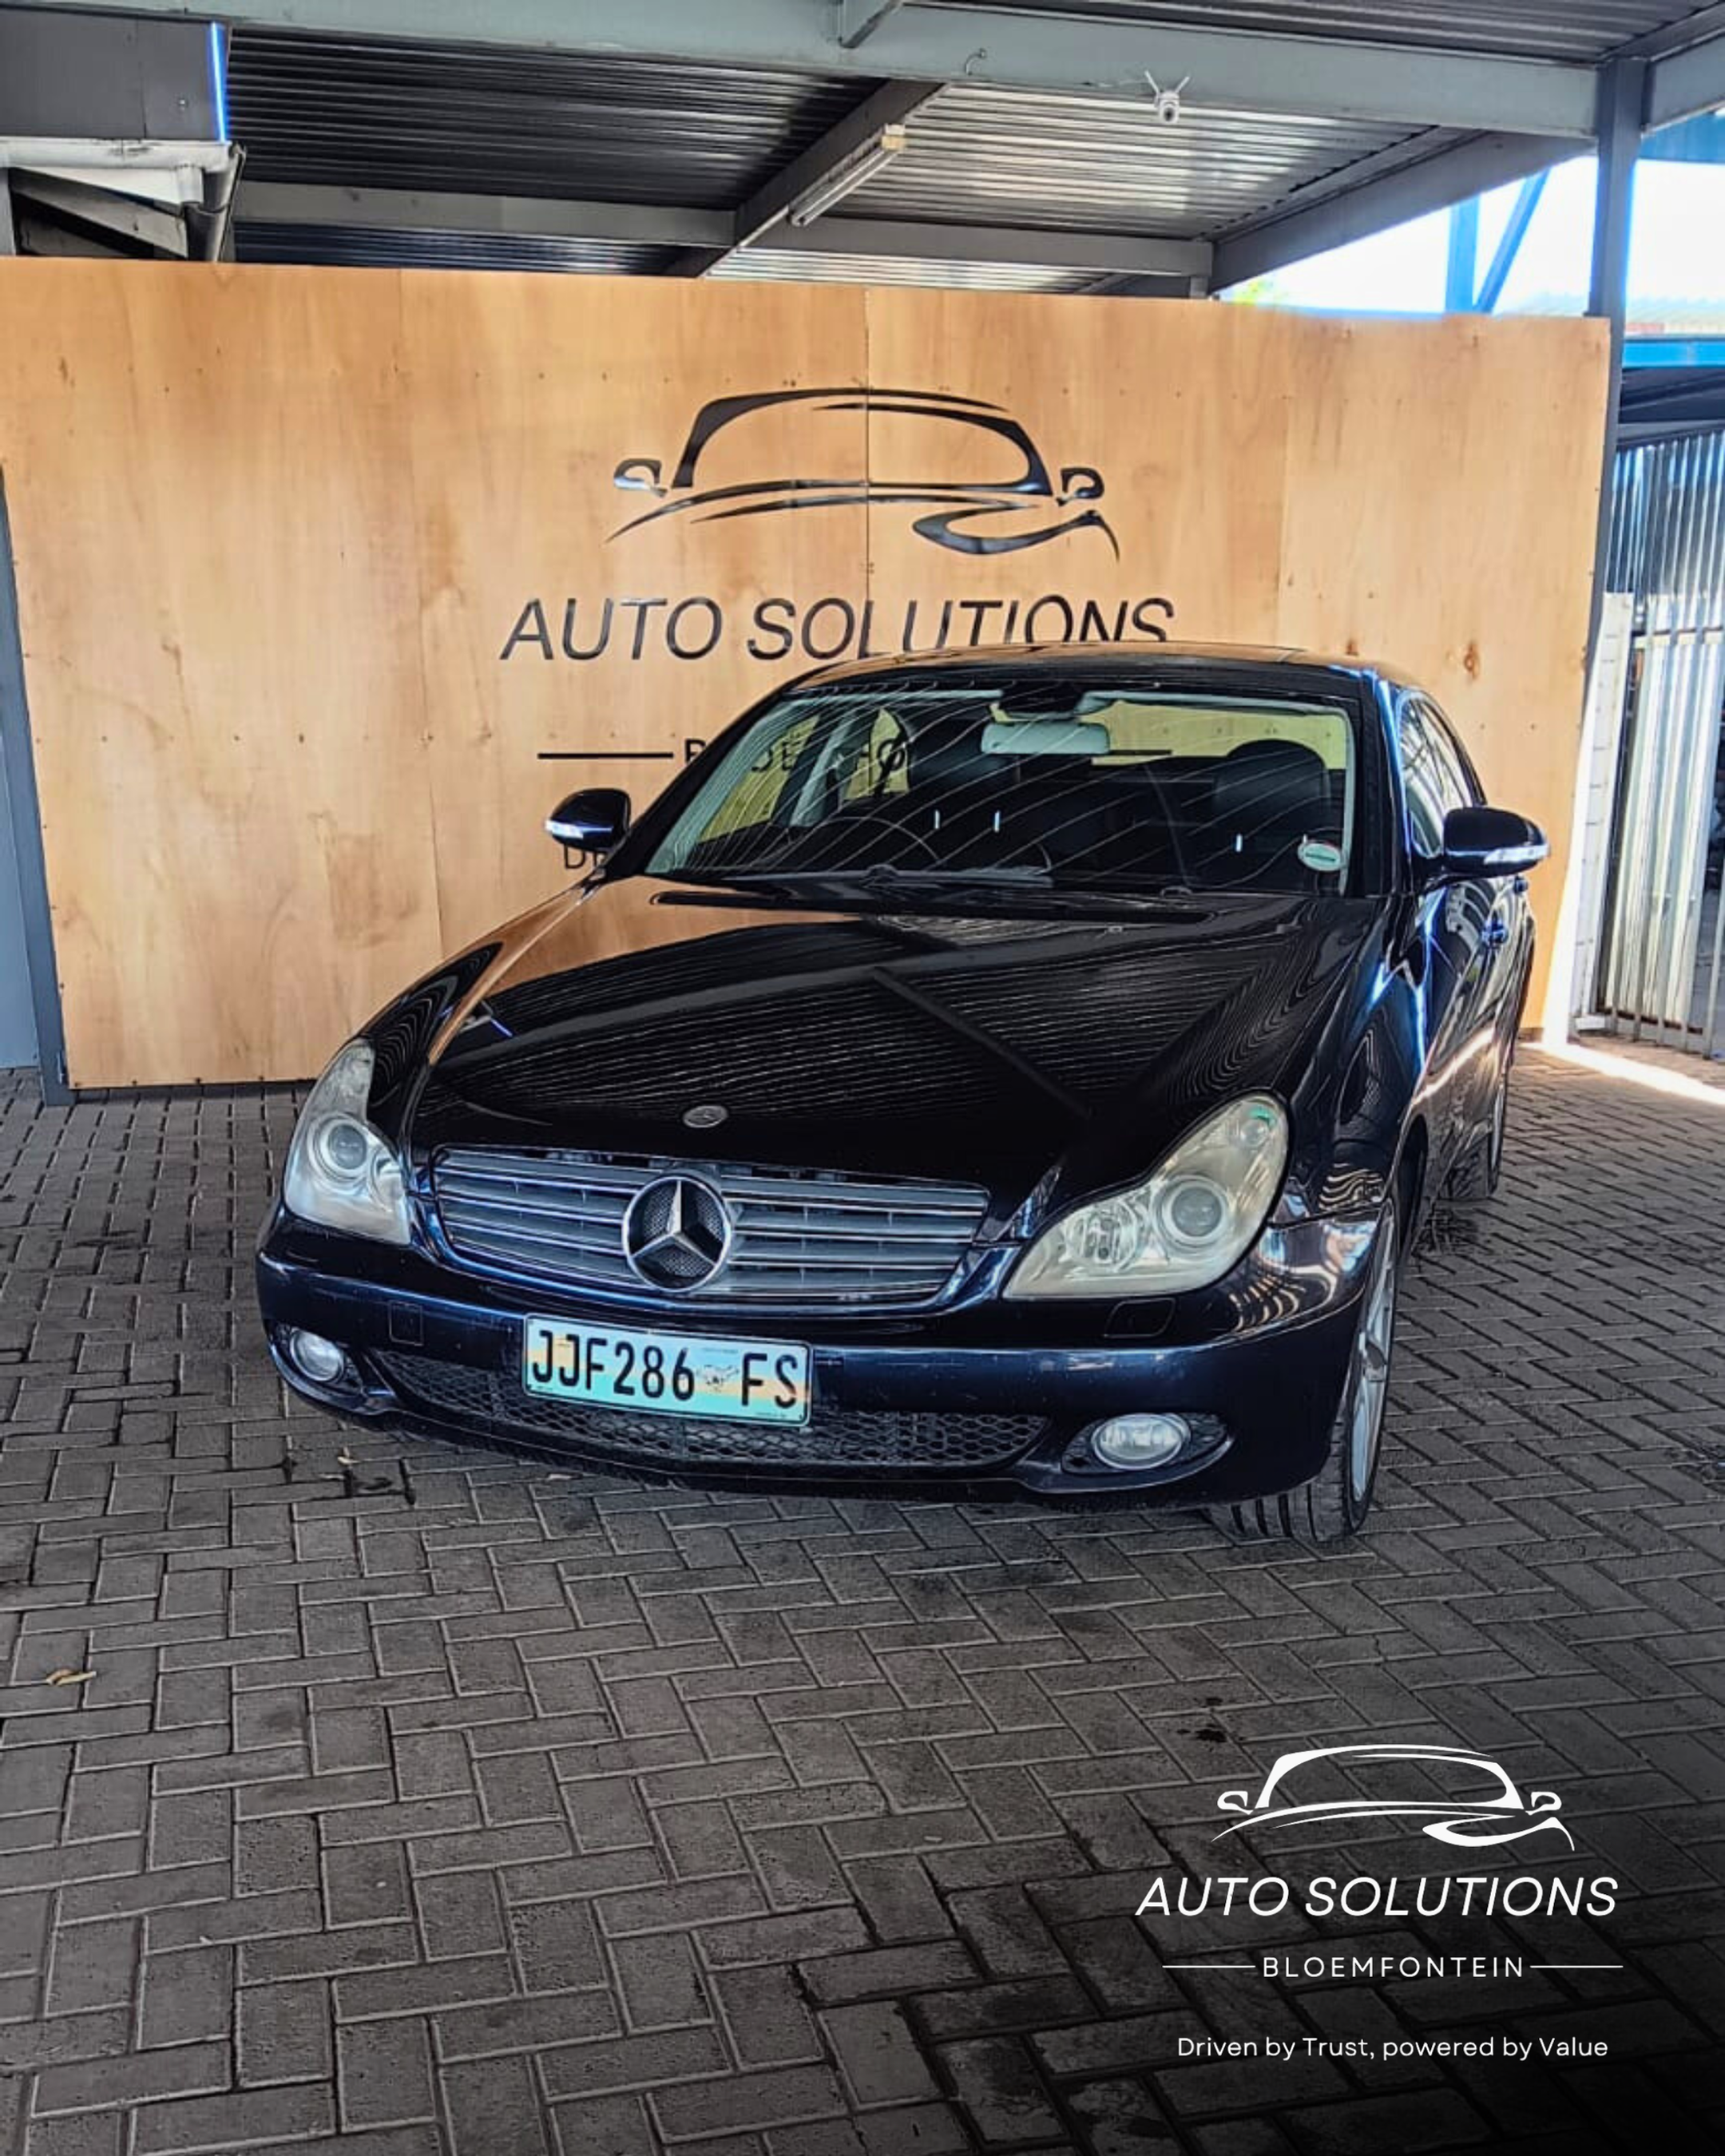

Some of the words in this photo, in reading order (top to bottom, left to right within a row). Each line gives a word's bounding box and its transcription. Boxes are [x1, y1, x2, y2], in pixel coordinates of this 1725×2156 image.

[499, 596, 722, 660] AUTO
[747, 595, 1174, 660] SOLUTIONS
[533, 1330, 695, 1401] JJF286
[742, 1353, 797, 1409] FS
